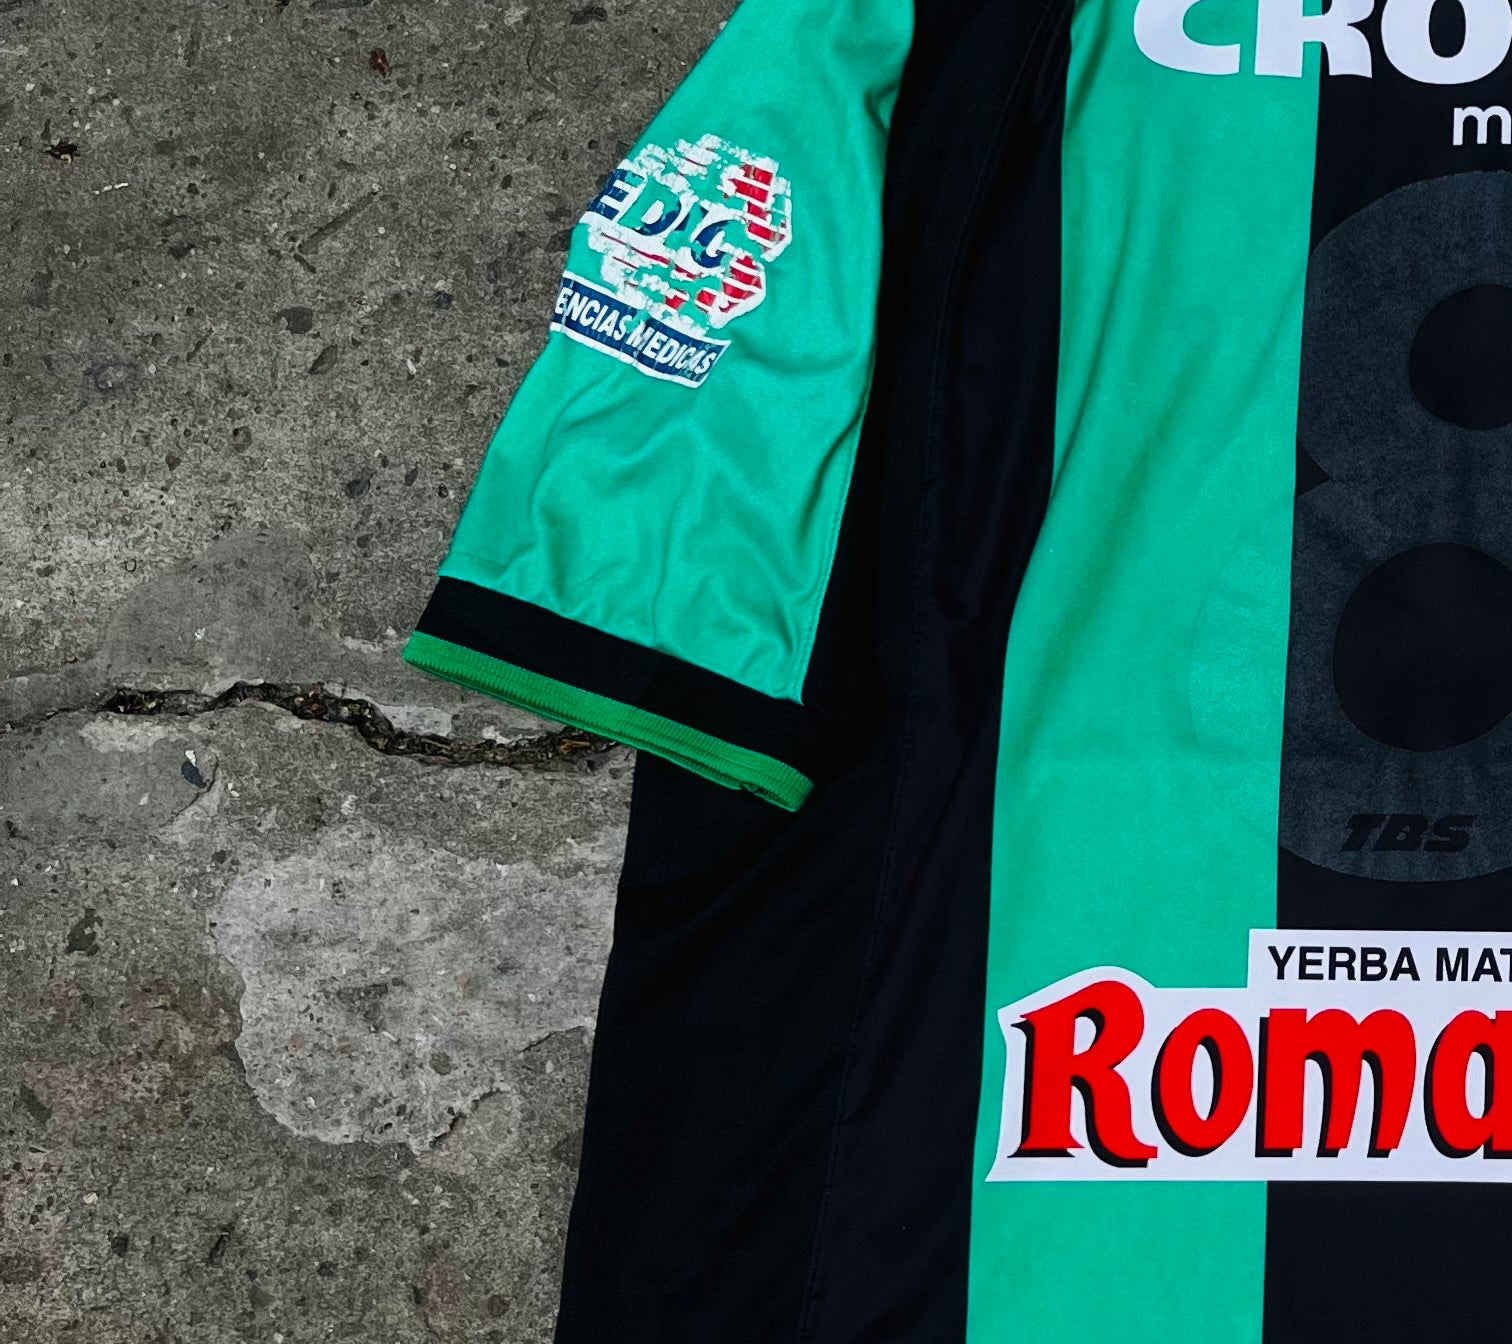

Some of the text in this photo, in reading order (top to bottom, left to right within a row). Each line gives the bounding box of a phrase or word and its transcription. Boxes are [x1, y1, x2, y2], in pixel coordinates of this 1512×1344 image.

[626, 321, 717, 375] MEDICAS
[1339, 813, 1478, 853] TBS
[1267, 945, 1420, 982] YERBA
